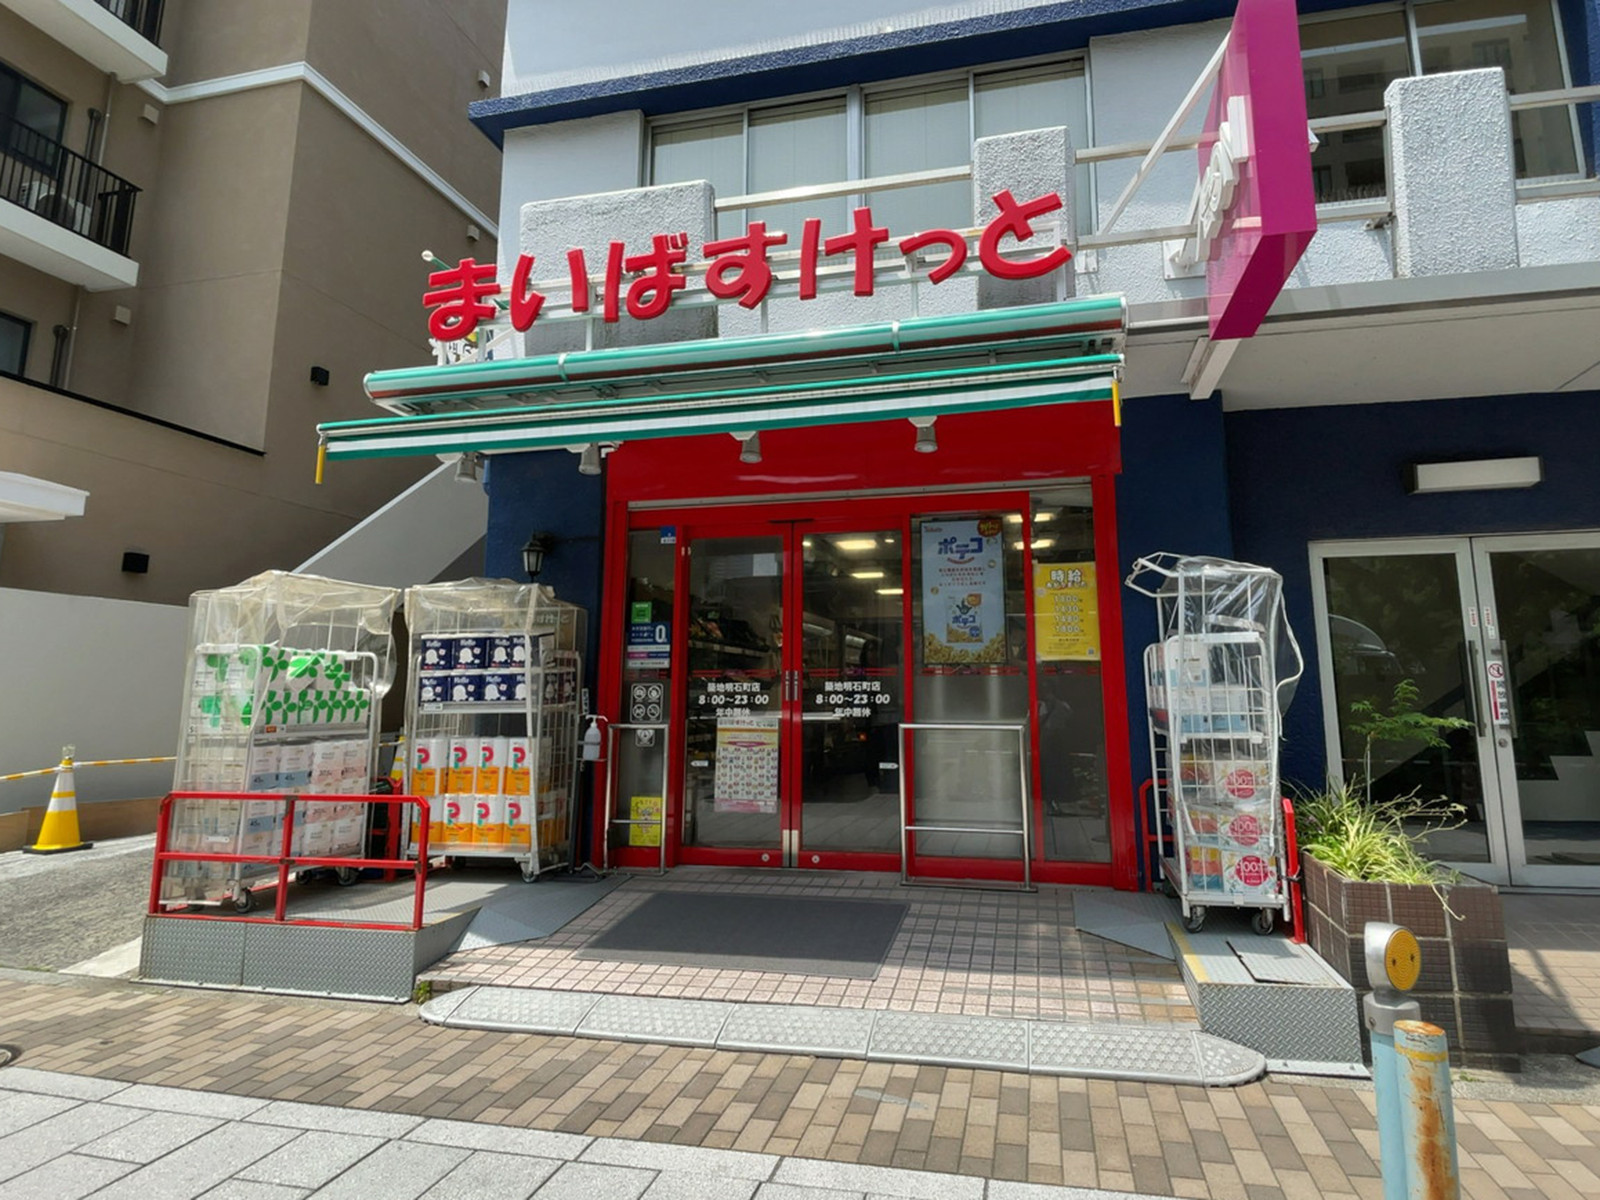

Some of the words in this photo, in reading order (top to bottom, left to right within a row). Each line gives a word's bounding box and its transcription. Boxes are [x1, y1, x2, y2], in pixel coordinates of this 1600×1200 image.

[422, 188, 1073, 342] まいばすけっと
[938, 536, 983, 560] ポテコ
[1050, 568, 1082, 583] 時給
[707, 682, 760, 692] 築地明石町店
[824, 681, 881, 692] 築地明石町店
